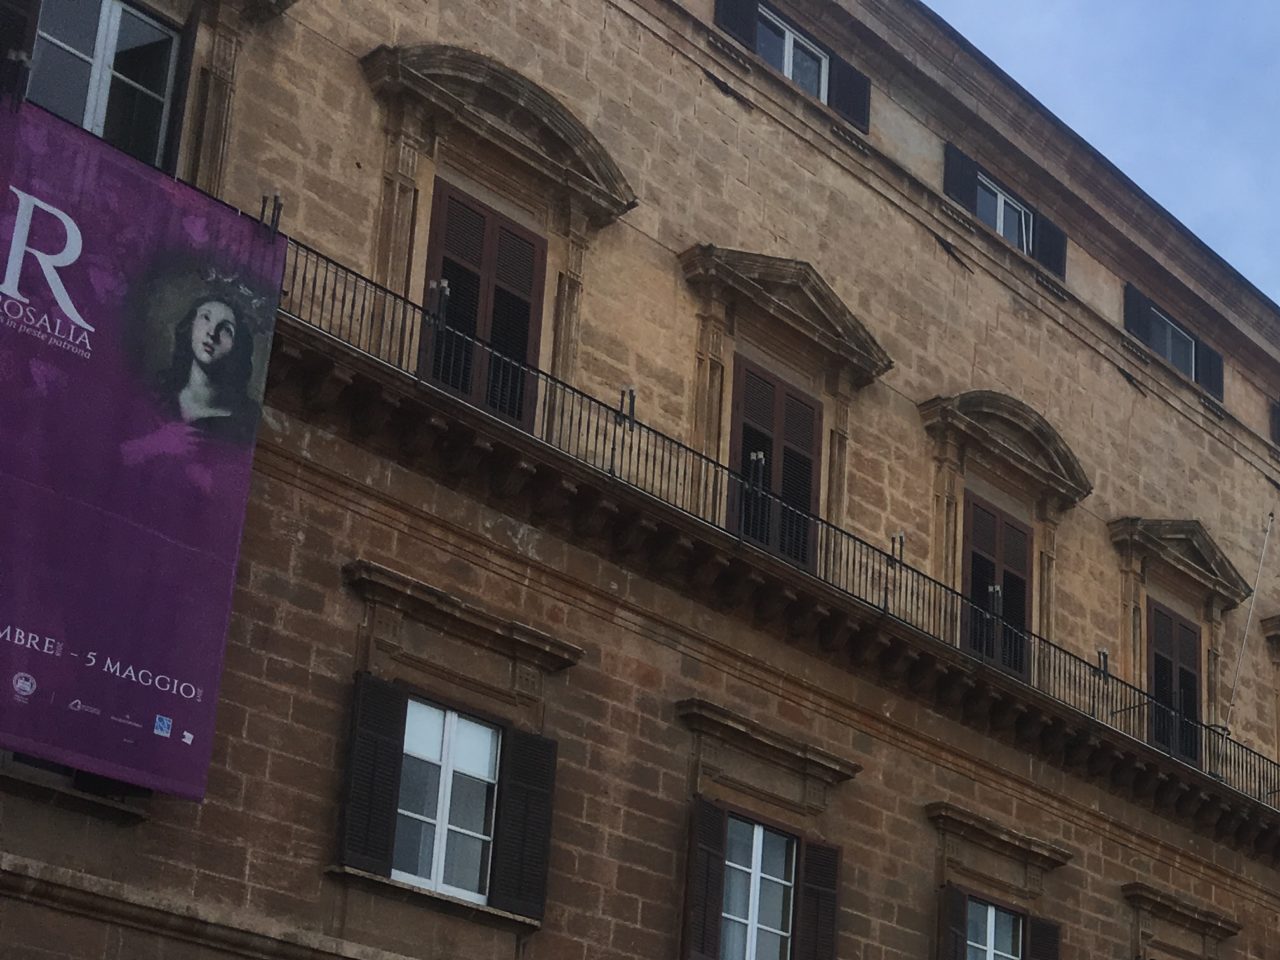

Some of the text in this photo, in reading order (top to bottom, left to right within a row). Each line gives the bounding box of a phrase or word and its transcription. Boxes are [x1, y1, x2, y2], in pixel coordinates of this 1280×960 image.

[0, 185, 95, 332] R
[0, 296, 93, 351] OSALIA
[84, 651, 97, 667] 5
[102, 657, 196, 699] MAGGIO
